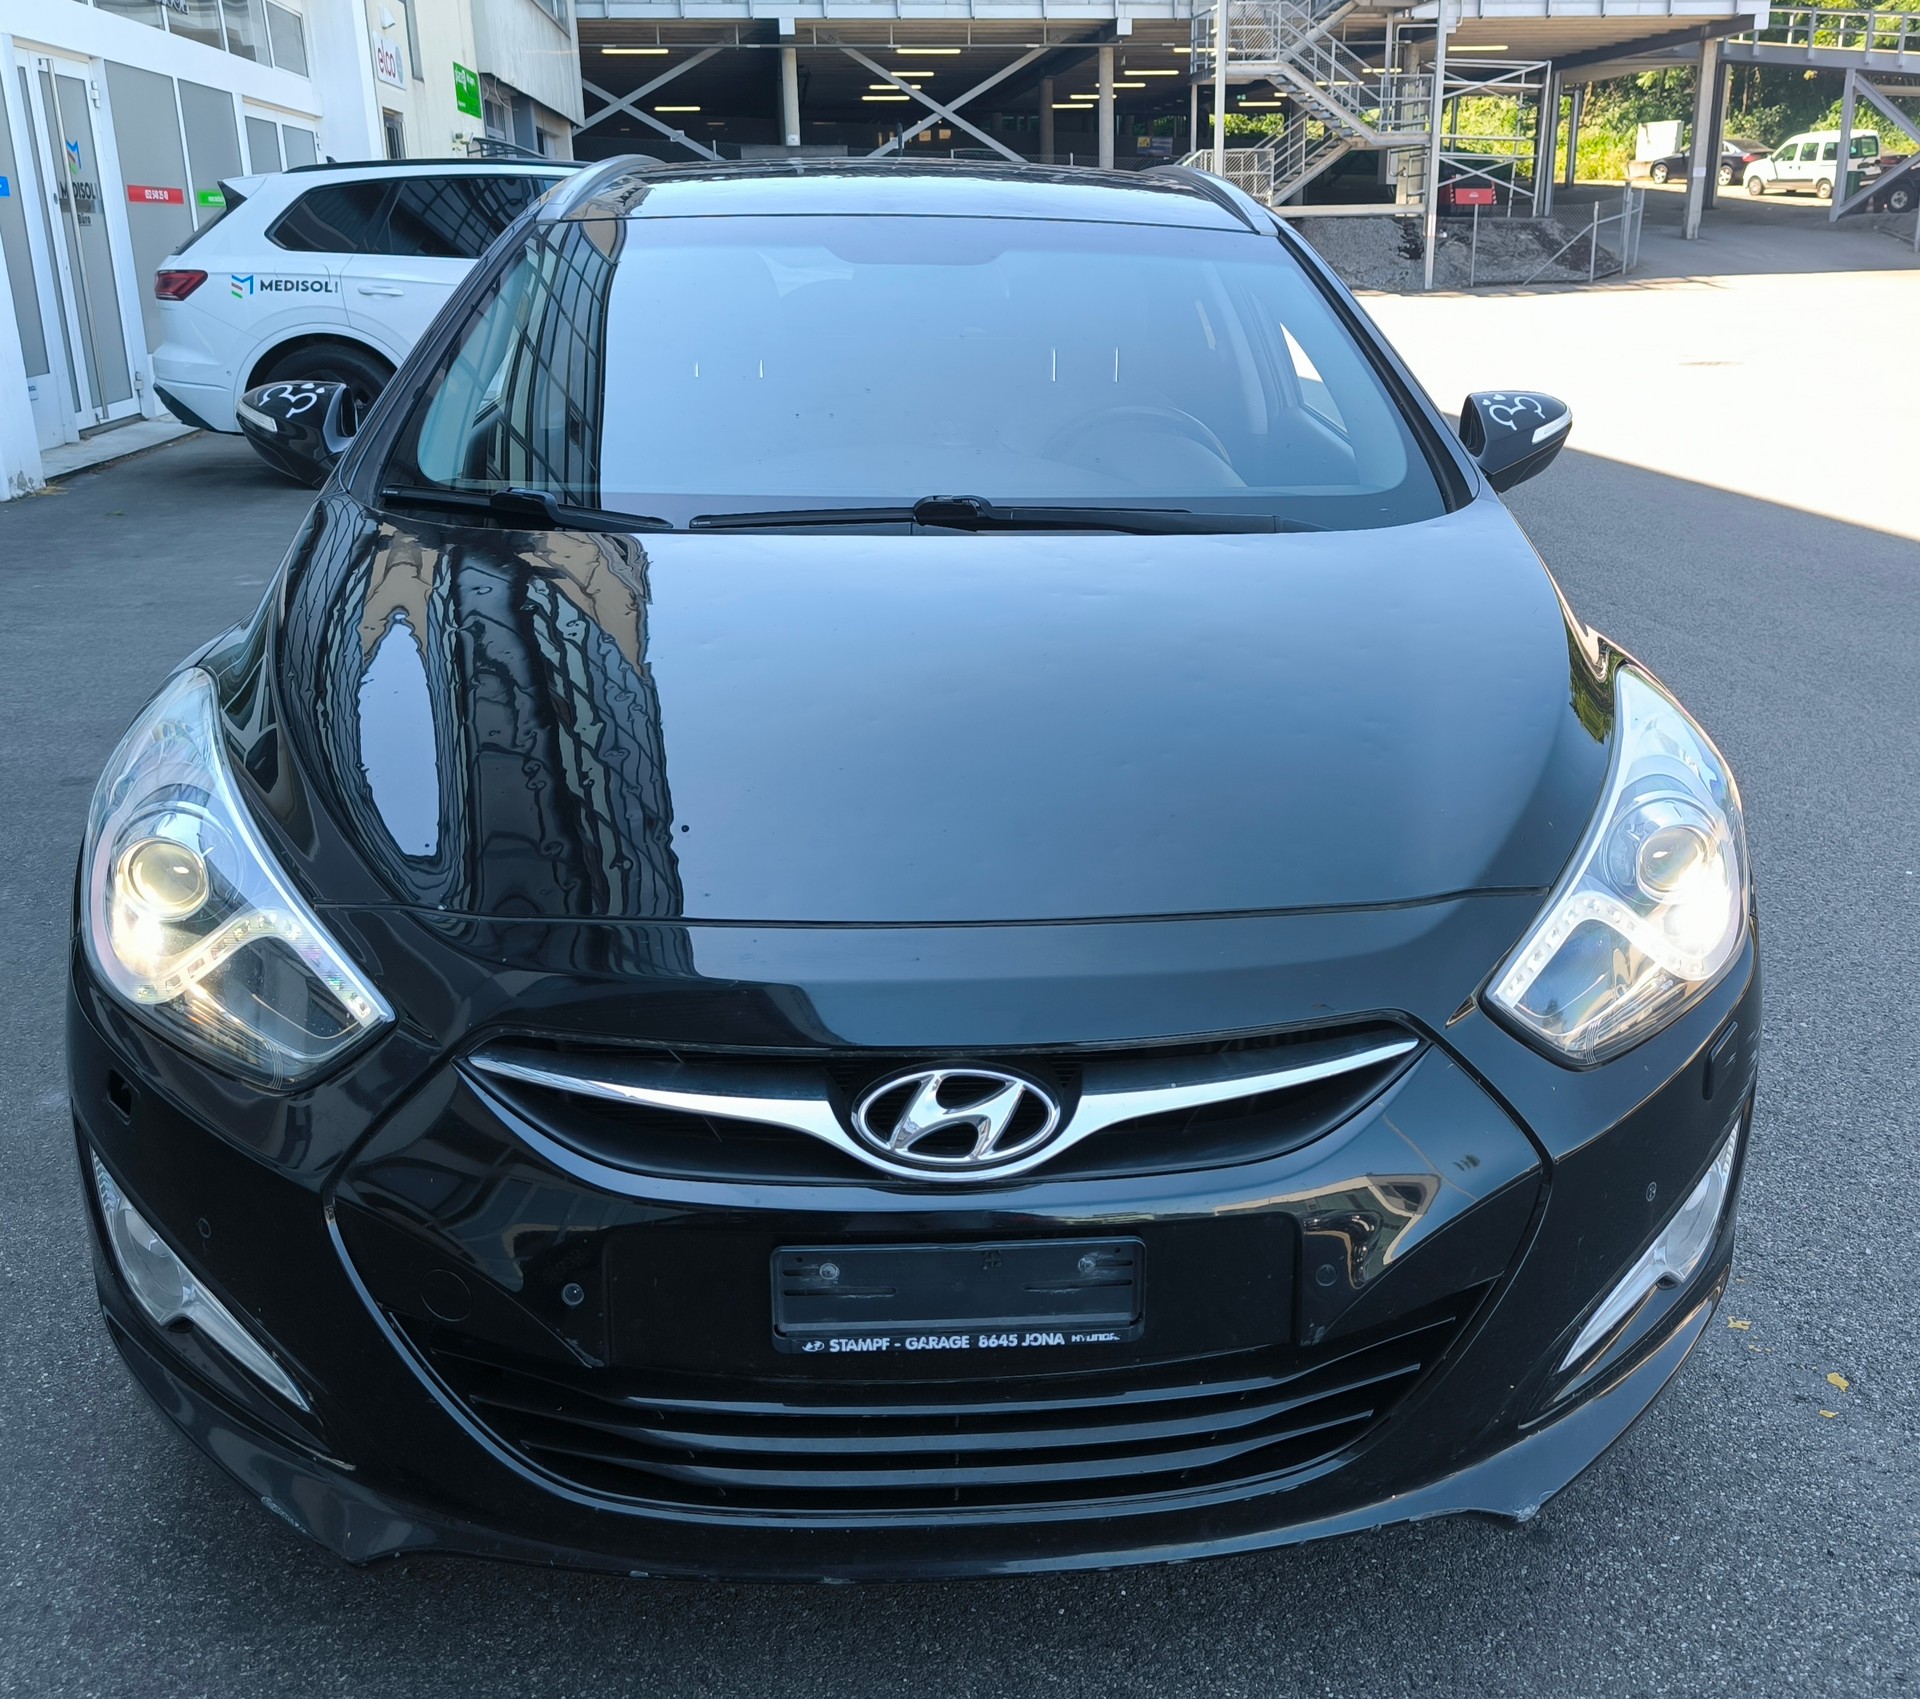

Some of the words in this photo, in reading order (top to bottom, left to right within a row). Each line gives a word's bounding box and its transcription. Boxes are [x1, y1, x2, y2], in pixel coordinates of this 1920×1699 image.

[59, 181, 96, 200] MDISOL
[260, 279, 333, 293] MEDISOL
[829, 1338, 891, 1353] STAMPF
[905, 1335, 970, 1350] GARAGE
[978, 1334, 1018, 1348] 8645
[1021, 1332, 1066, 1347] JONA
